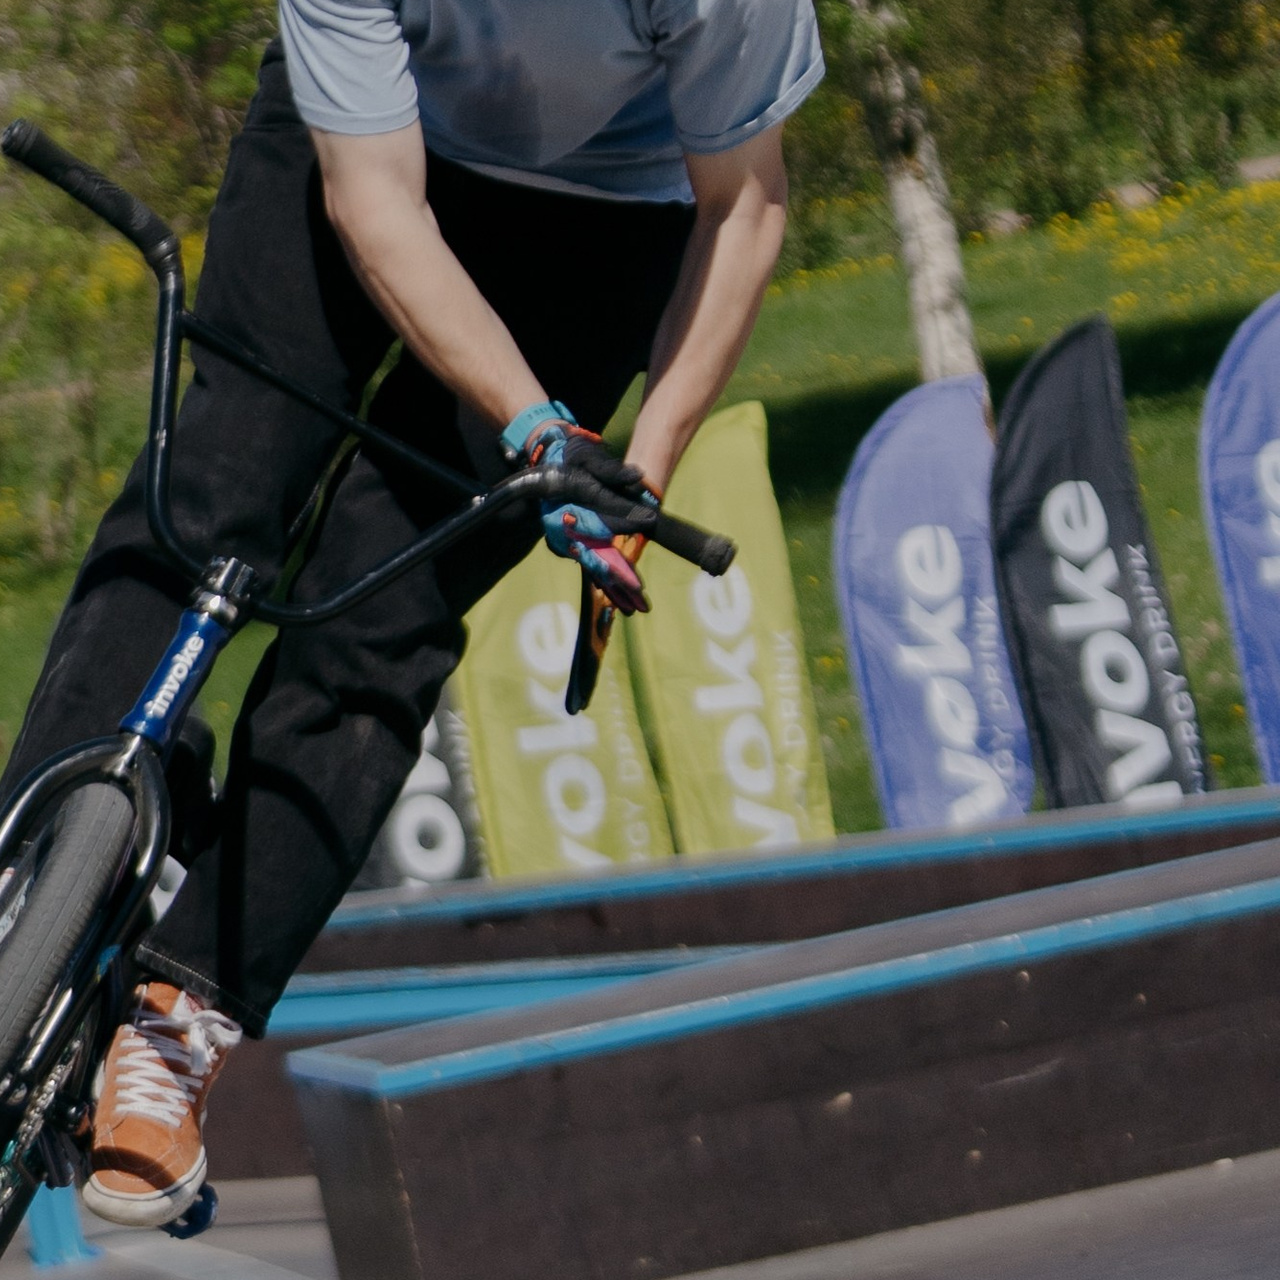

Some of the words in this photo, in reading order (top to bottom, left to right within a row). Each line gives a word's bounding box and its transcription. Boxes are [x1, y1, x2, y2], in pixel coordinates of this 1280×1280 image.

[1040, 480, 1184, 808] voke
[1126, 542, 1180, 661] DRINK
[144, 635, 205, 719] invoke
[774, 630, 807, 748] DRINK
[898, 525, 1007, 827] voke
